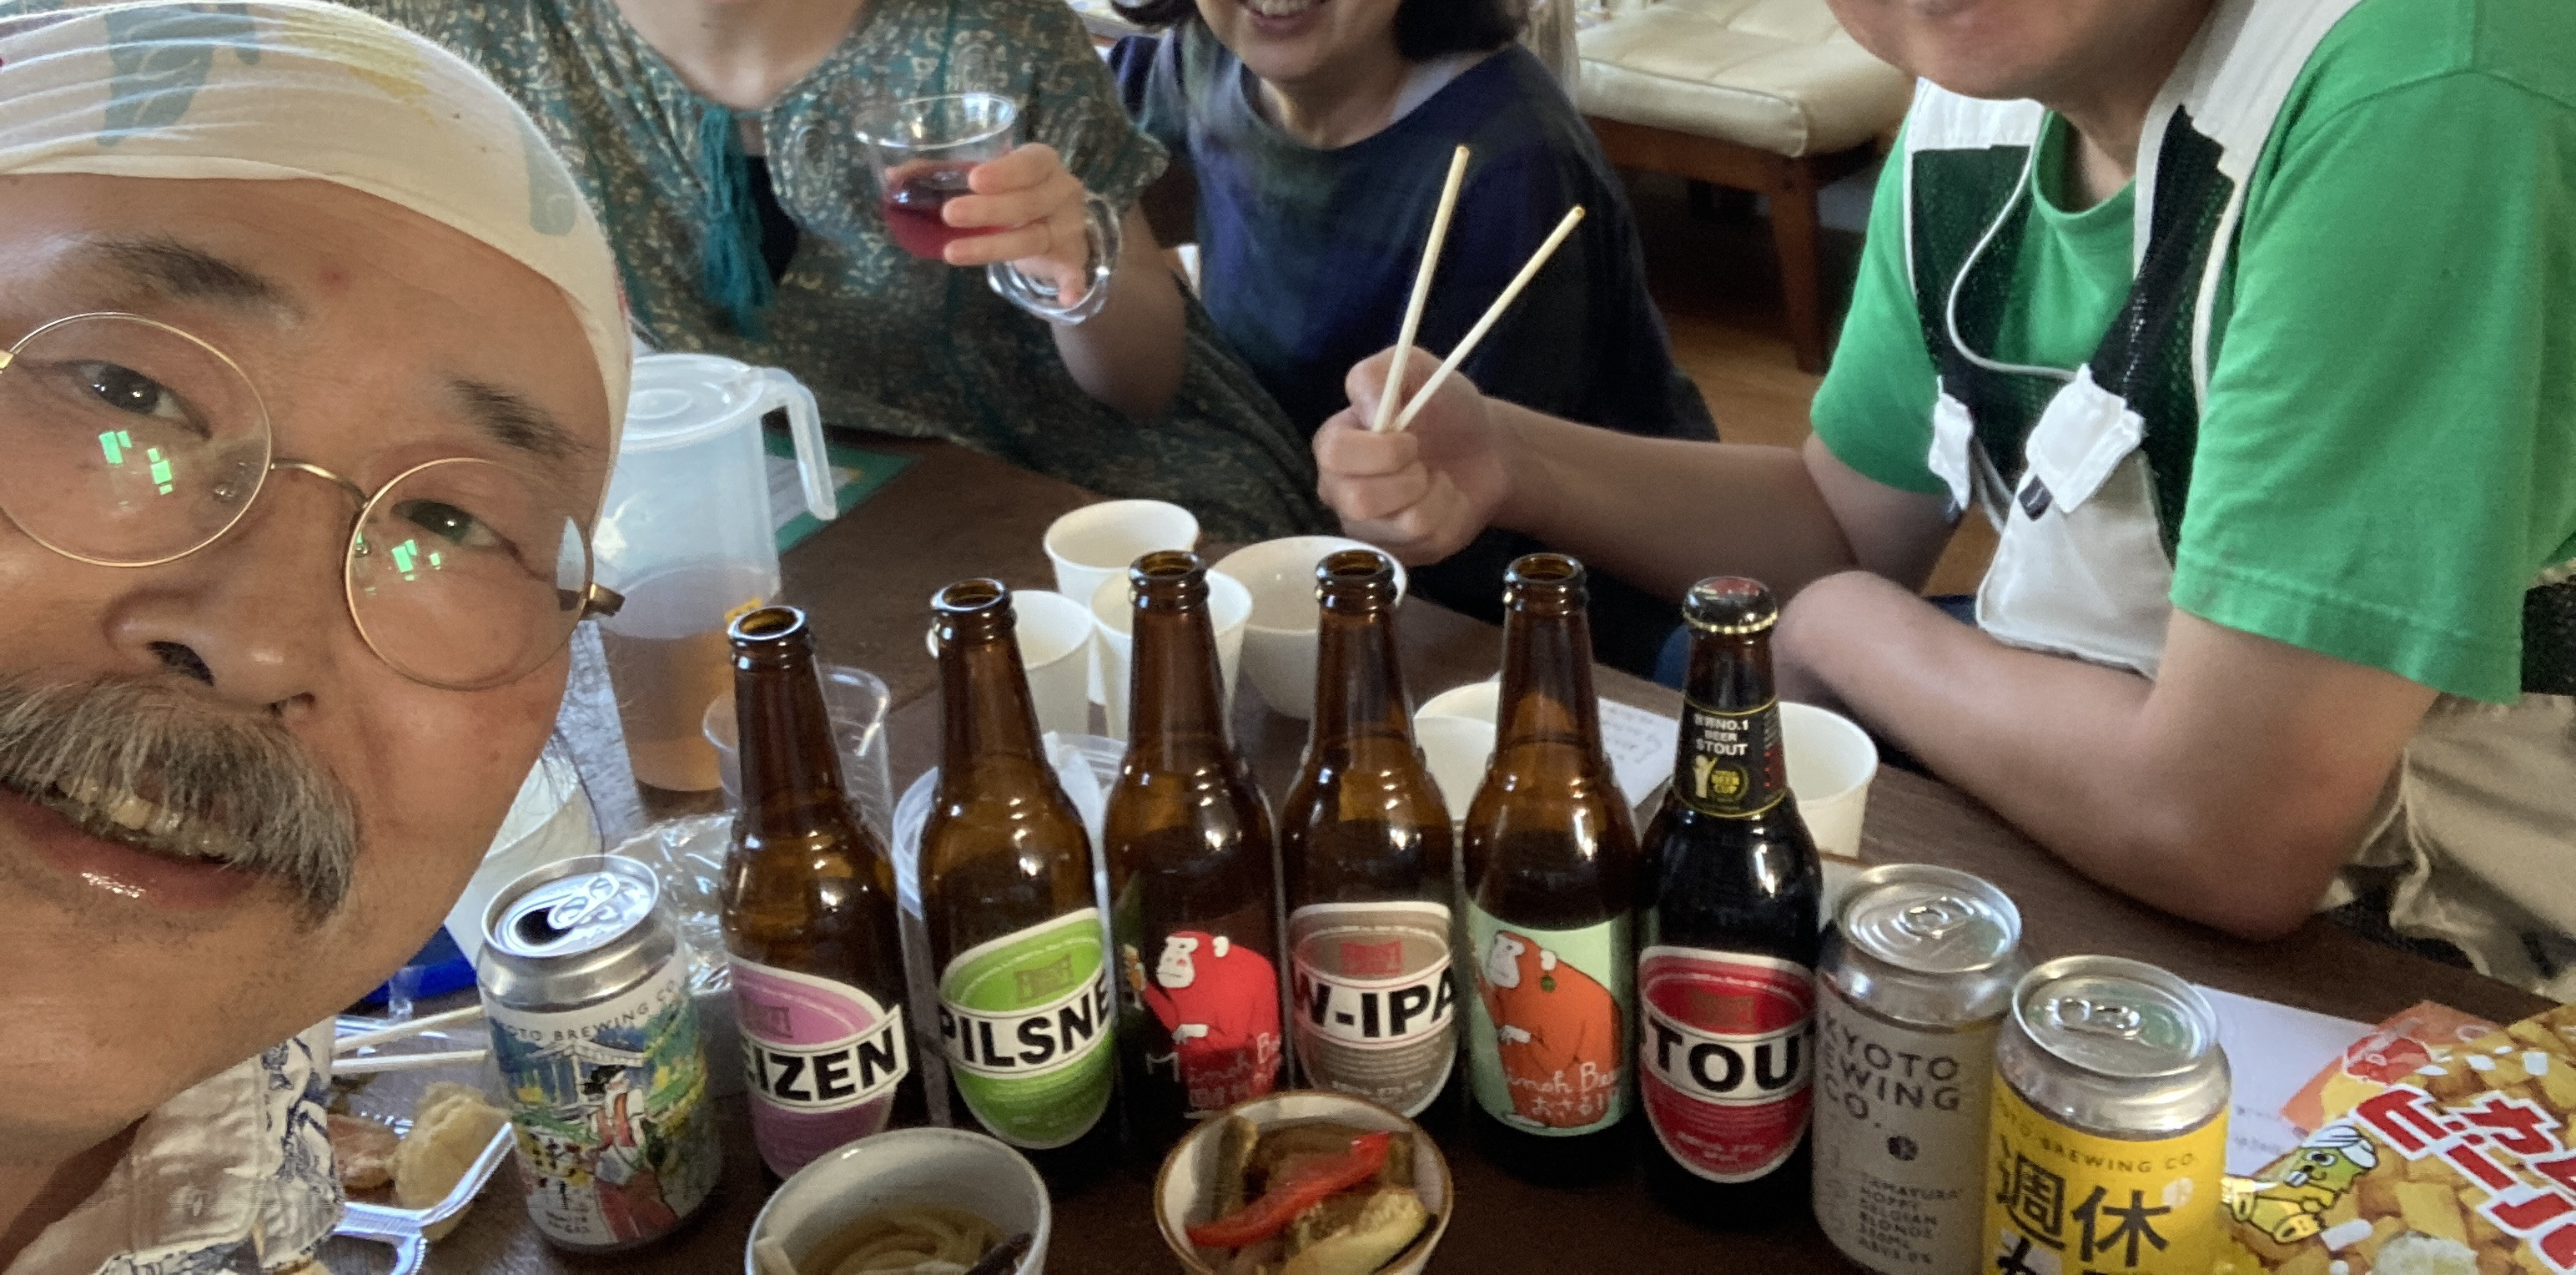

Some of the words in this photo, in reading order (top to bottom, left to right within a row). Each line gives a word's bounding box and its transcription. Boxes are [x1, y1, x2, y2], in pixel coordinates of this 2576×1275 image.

[1695, 738, 1748, 756] STOUT
[554, 1002, 649, 1041] BREWING
[2040, 1136, 2151, 1173] BREWING
